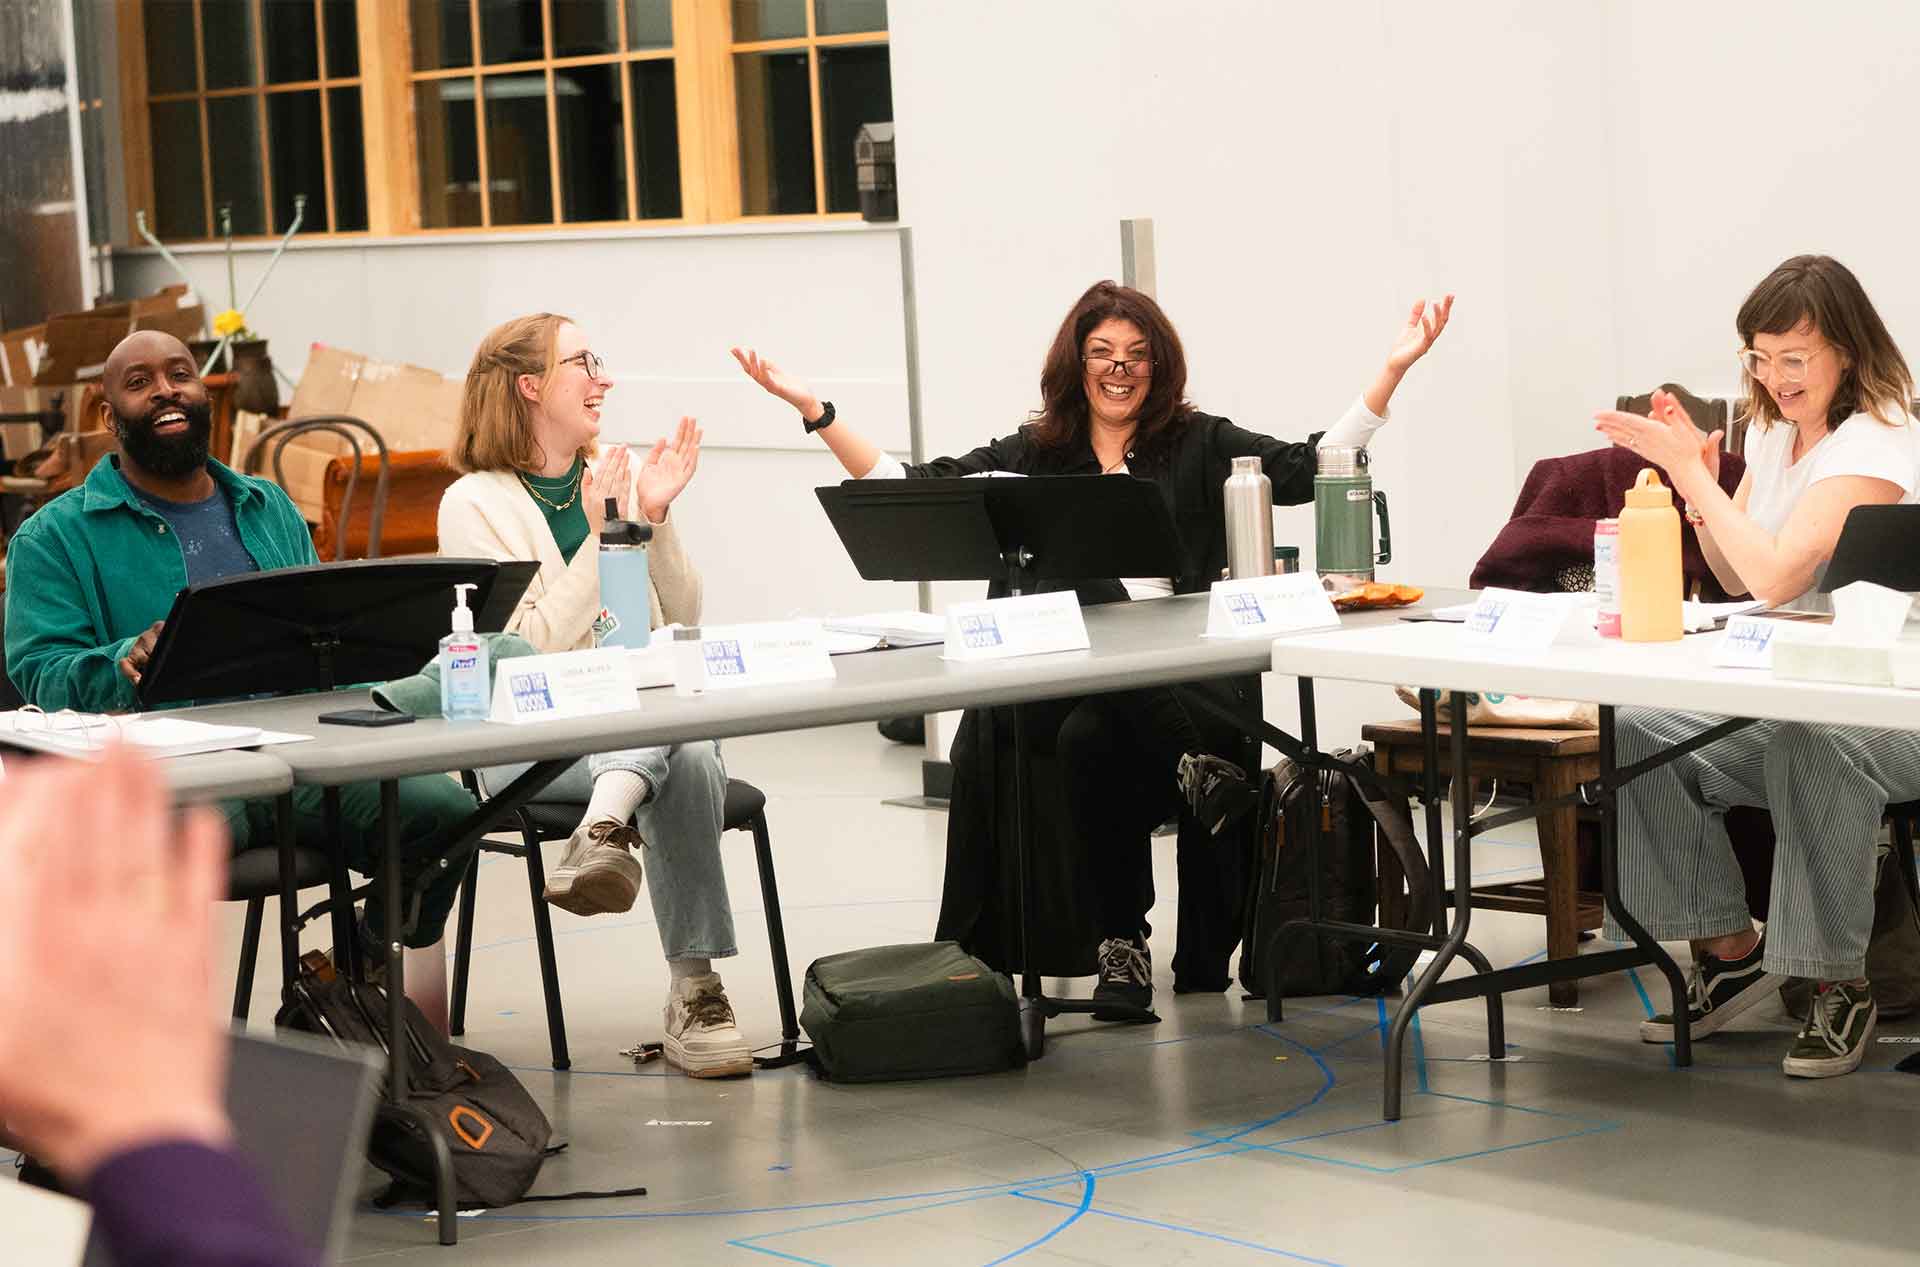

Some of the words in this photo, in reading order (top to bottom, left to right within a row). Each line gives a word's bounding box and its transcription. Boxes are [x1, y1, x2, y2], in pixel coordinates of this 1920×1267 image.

[703, 641, 723, 658] INTO
[723, 640, 740, 656] THE
[510, 674, 530, 693] INTO
[530, 672, 548, 691] THE
[515, 692, 547, 713] WOODS
